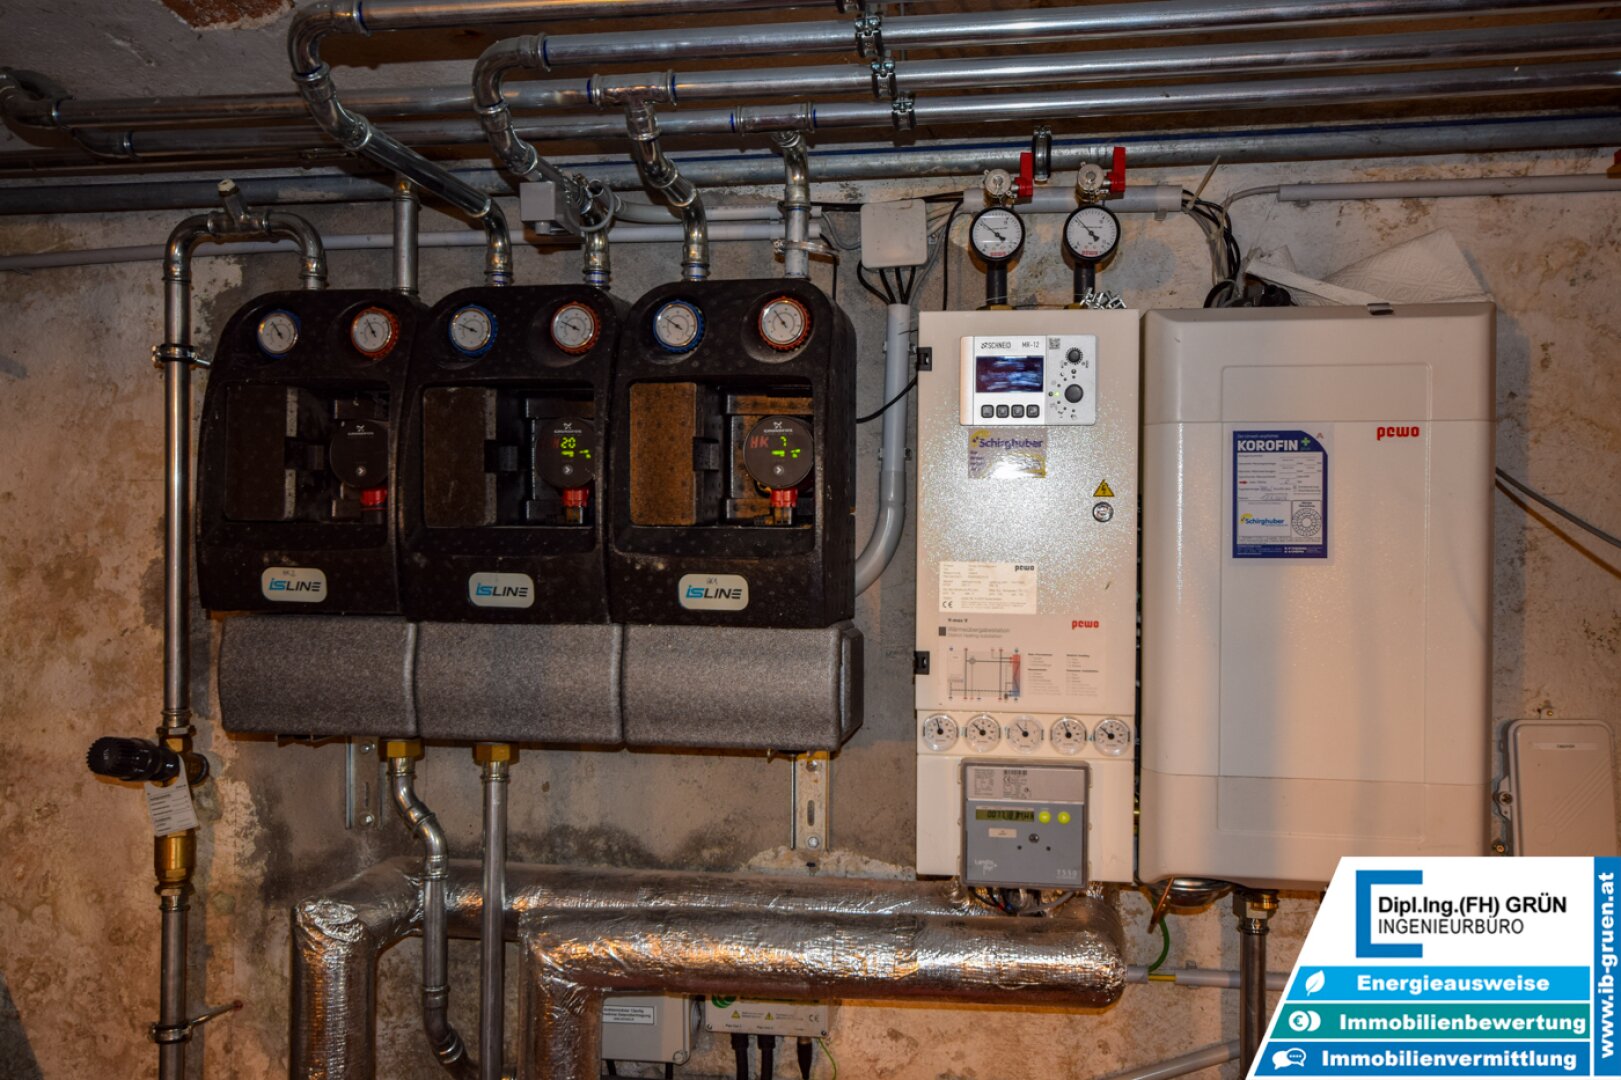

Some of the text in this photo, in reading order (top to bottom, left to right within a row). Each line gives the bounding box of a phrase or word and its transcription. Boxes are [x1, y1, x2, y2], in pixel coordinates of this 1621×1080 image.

[1376, 426, 1420, 441] pewo
[979, 438, 1044, 450] Schirghuber
[1237, 439, 1298, 451] KOROFIN
[1244, 517, 1285, 525] Schirghuber
[1014, 564, 1035, 572] pewo
[1071, 619, 1100, 630] pewo
